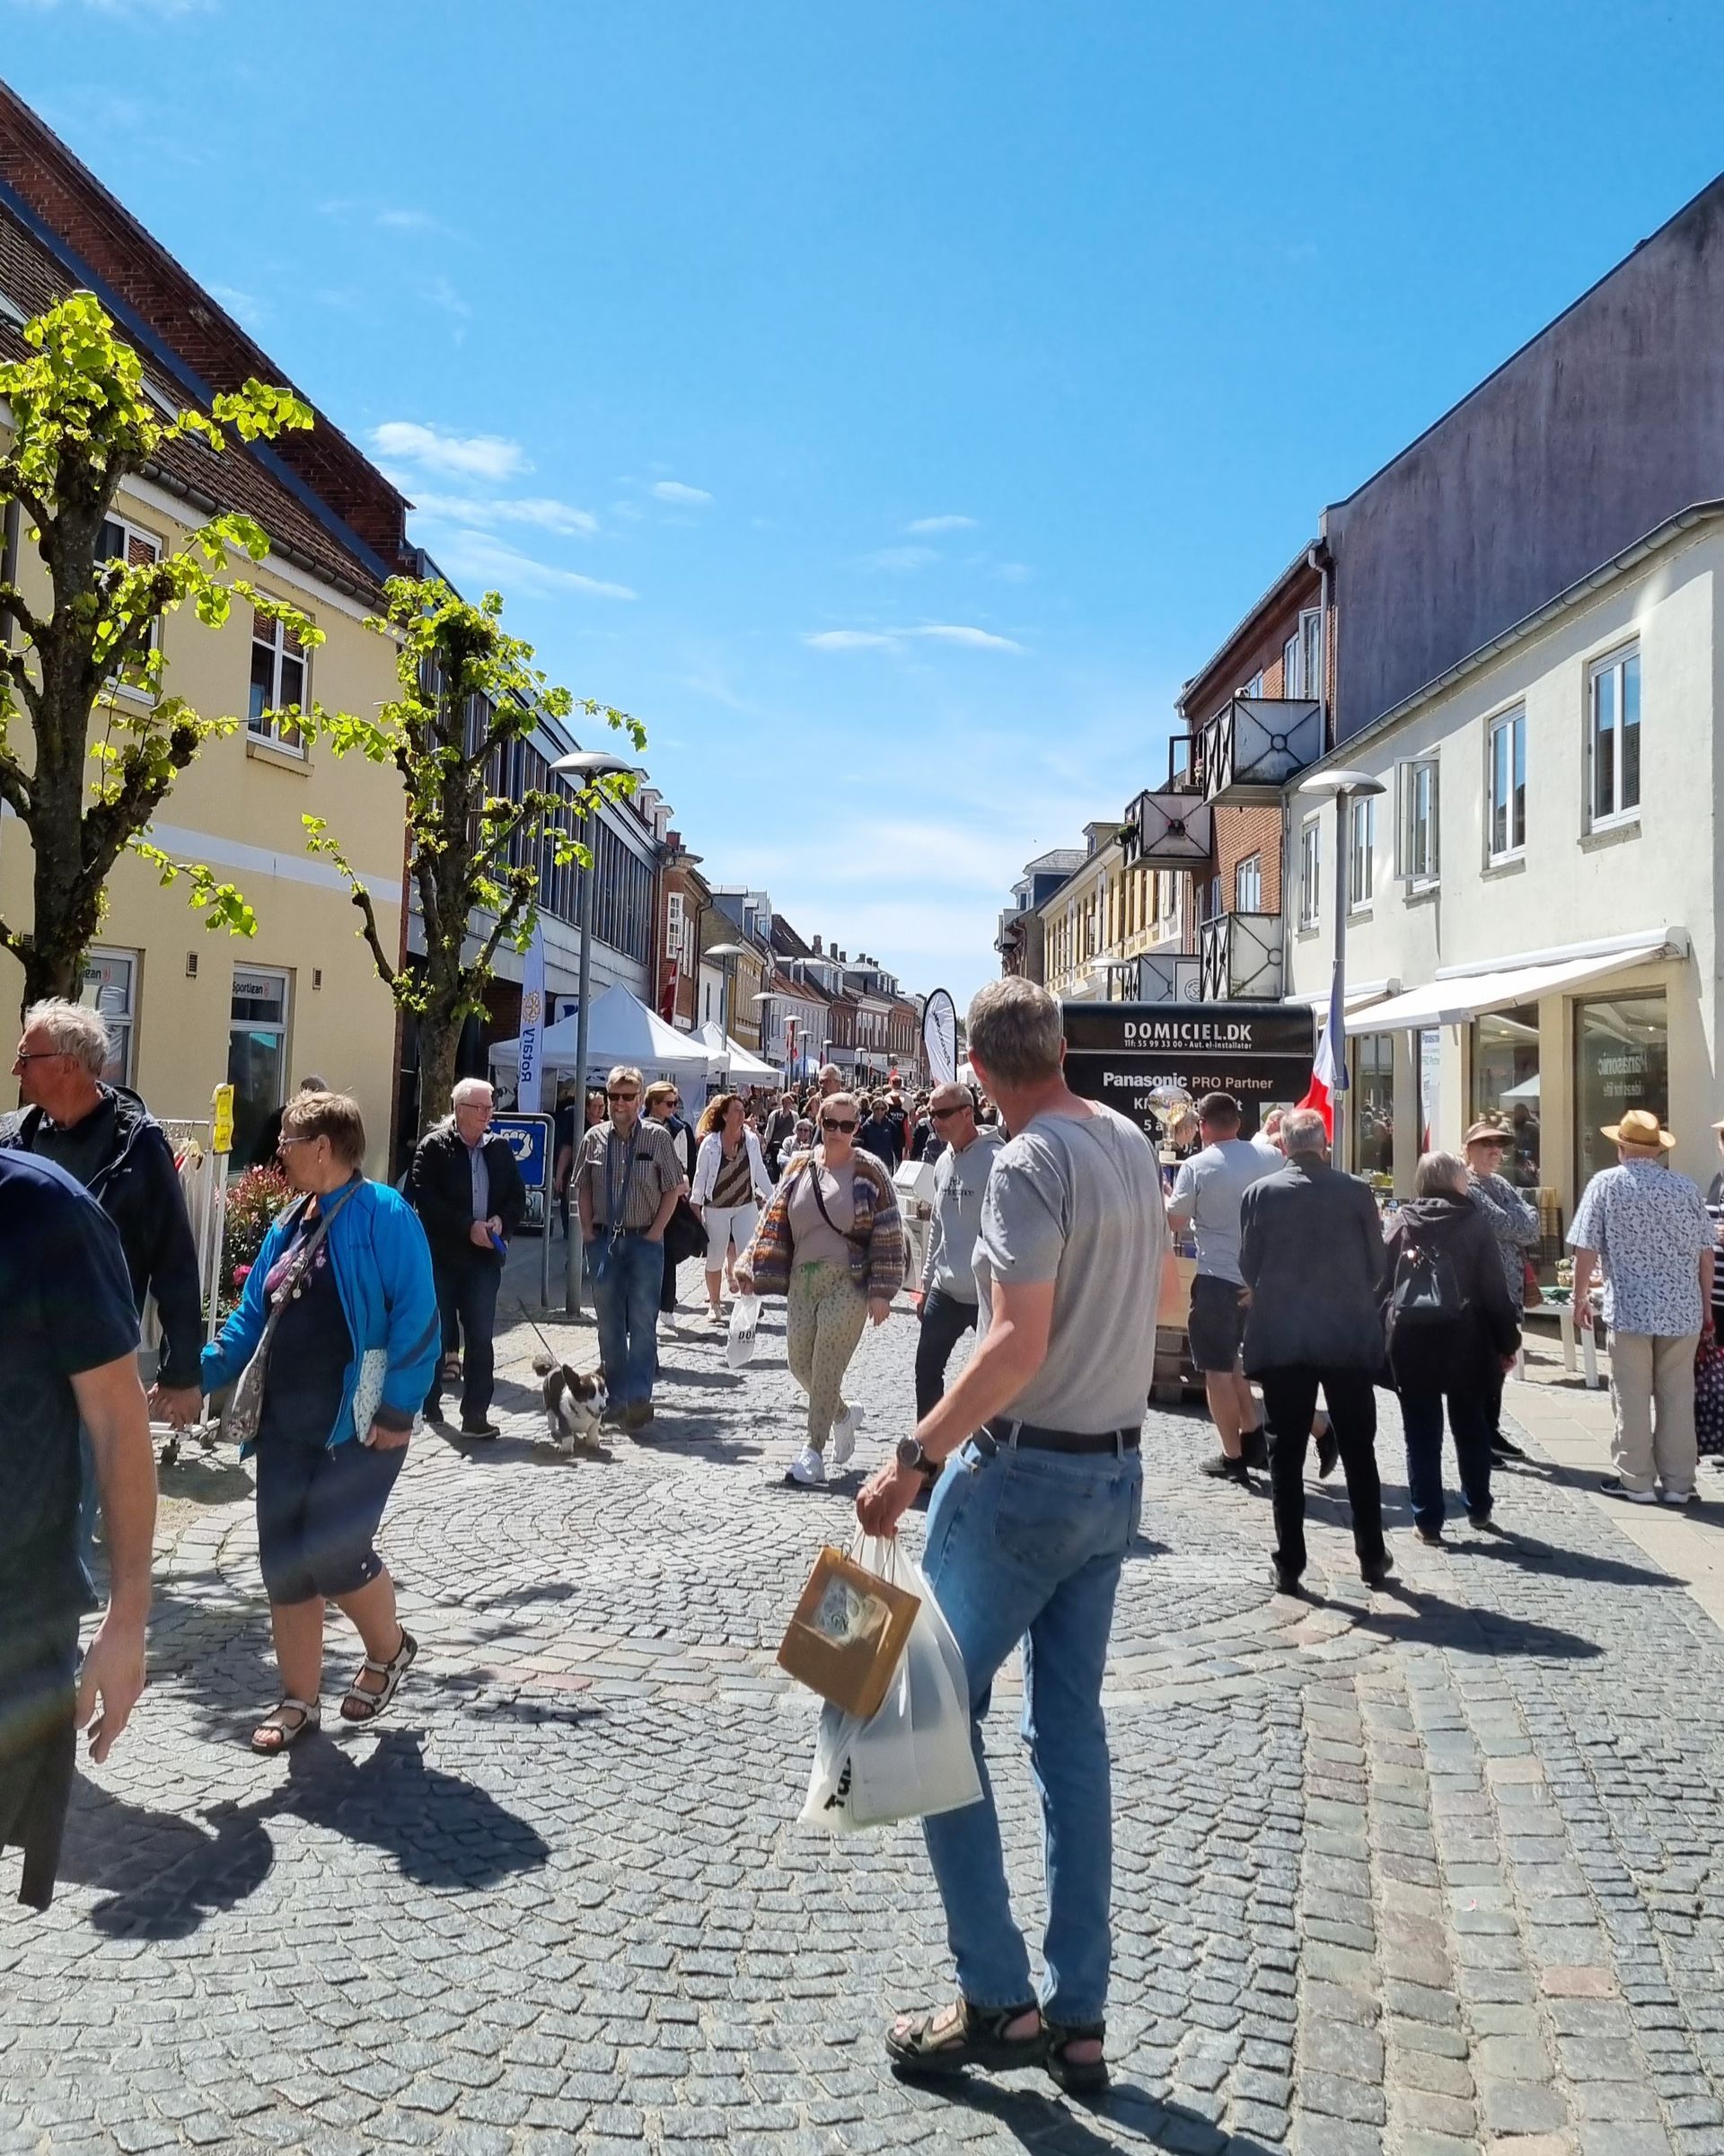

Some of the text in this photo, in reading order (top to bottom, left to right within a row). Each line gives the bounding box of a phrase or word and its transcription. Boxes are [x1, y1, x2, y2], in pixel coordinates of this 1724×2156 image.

[1124, 1022, 1252, 1041] DOMICIEL.DK
[1124, 1040, 1136, 1048] Tlf:
[1138, 1040, 1148, 1048] 55
[1149, 1040, 1159, 1048] 99
[1161, 1041, 1171, 1049] 33
[1173, 1041, 1183, 1049] 00
[1189, 1041, 1204, 1049] Aut.
[1103, 1072, 1273, 1089] Panasonic PRO Partner
[1143, 1119, 1152, 1131] 5
